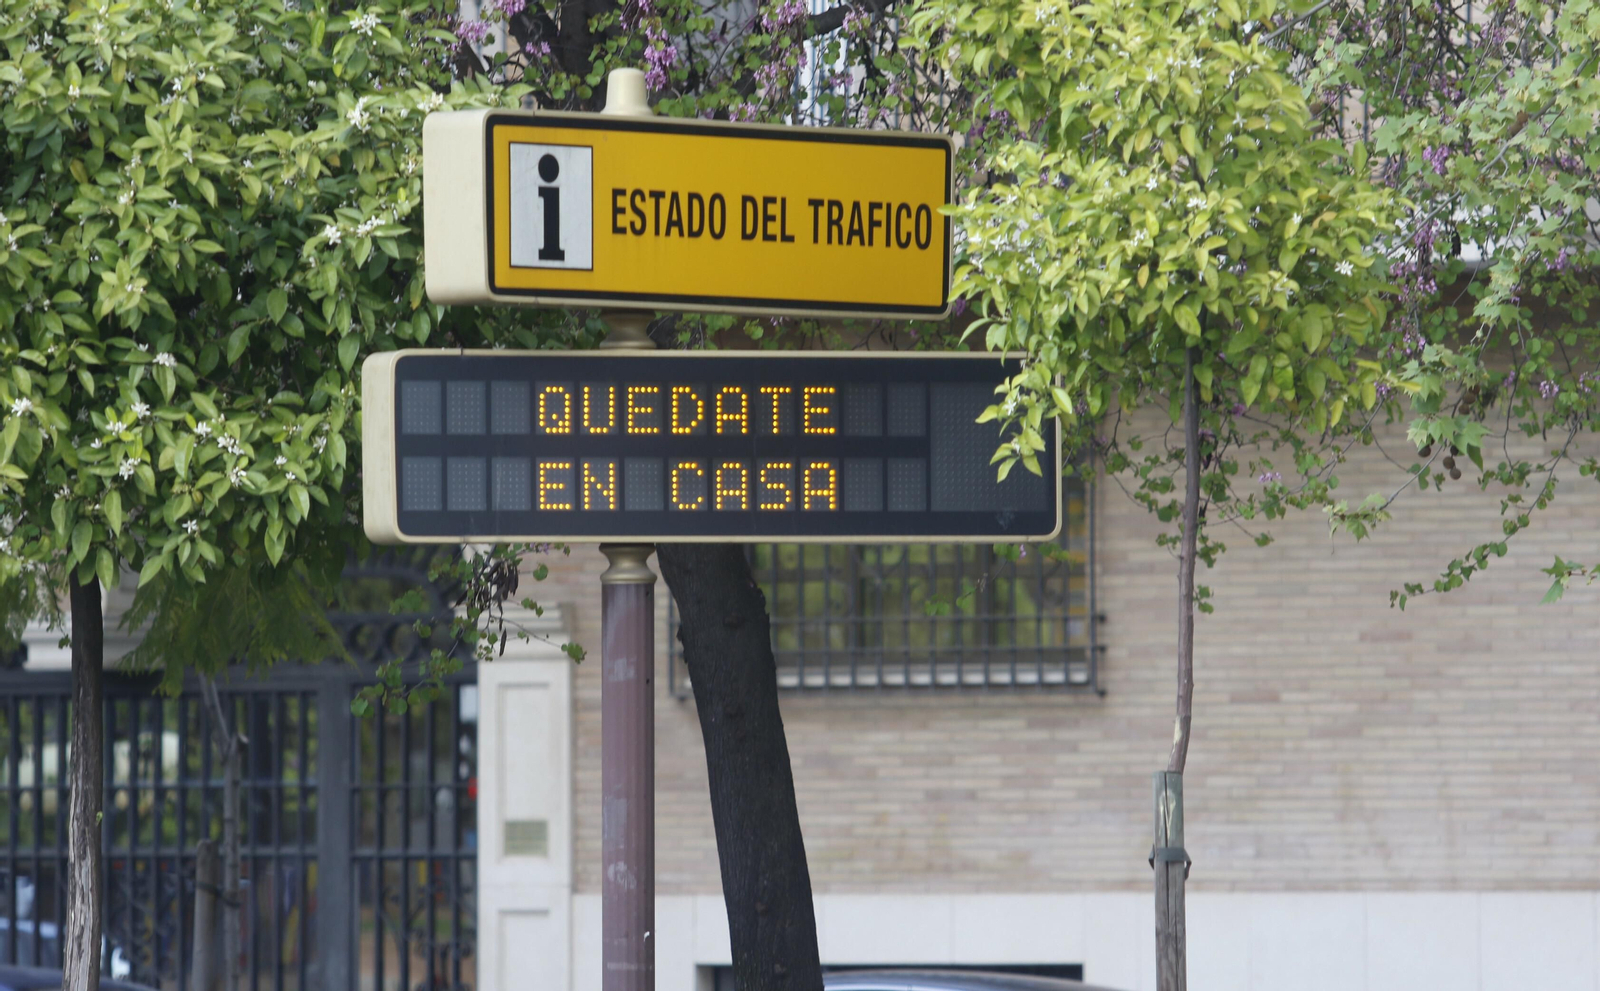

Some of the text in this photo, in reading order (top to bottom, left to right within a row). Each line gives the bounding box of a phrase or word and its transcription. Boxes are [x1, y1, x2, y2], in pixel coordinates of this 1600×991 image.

[611, 188, 933, 251] ESTADO DEL TRAFICO
[537, 385, 837, 435] QUEDATE
[538, 461, 838, 511] EN CASA
